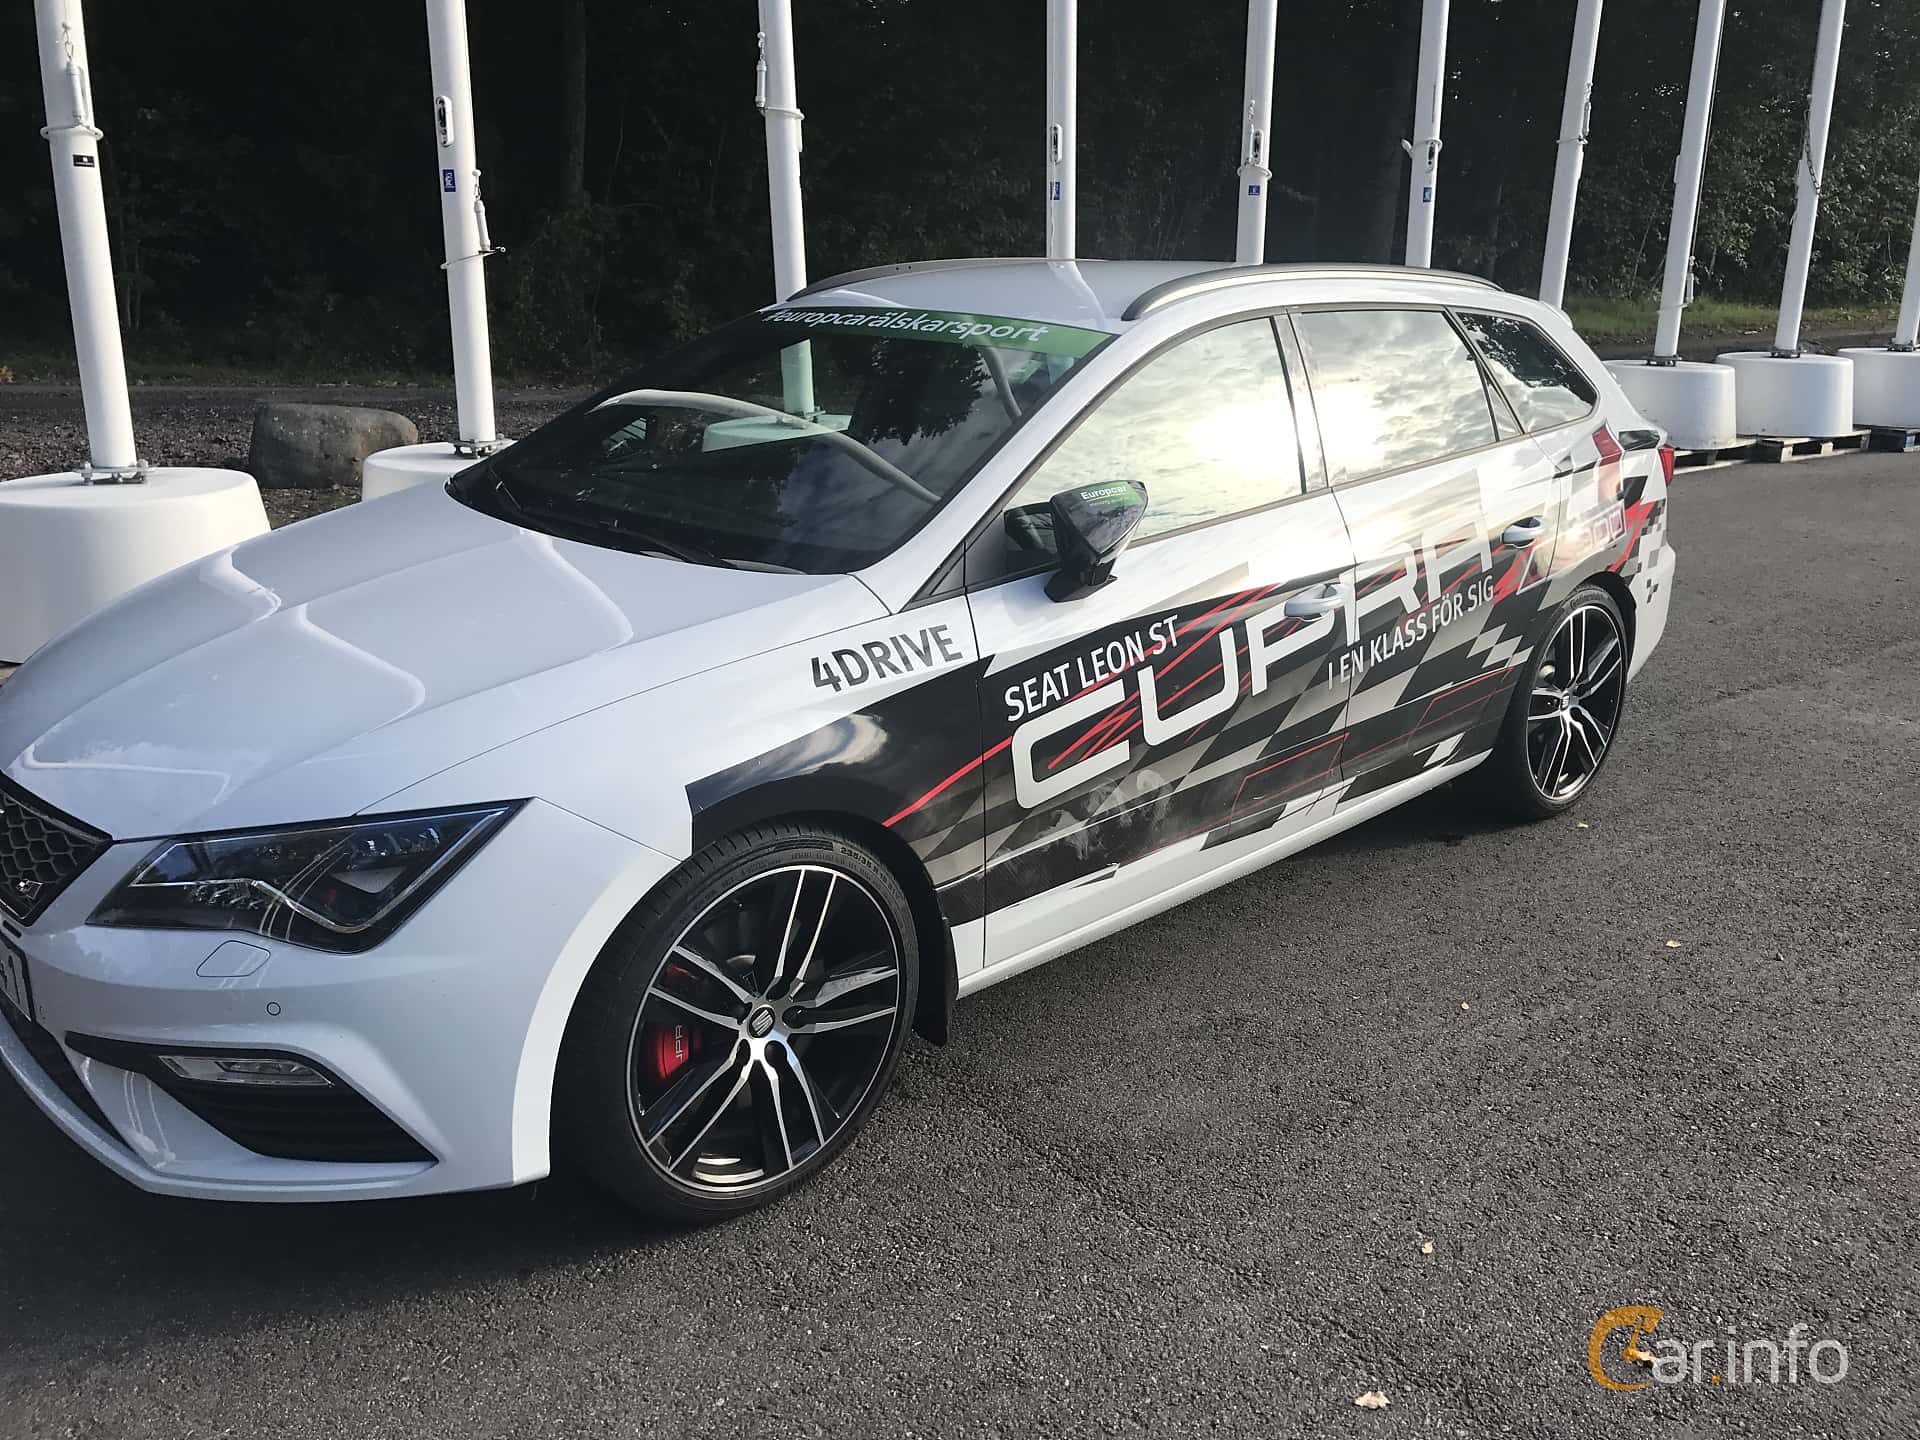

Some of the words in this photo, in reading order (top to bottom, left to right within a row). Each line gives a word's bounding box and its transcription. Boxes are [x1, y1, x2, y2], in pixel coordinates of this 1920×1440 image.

[810, 624, 963, 693] 4DRIVE
[1004, 662, 1070, 722] SEAT
[1077, 631, 1146, 689] LEON
[1149, 614, 1179, 655] ST
[1011, 500, 1494, 809] CUPRA
[1340, 645, 1364, 684] EN
[1370, 612, 1428, 668] KLASS
[1432, 592, 1464, 632] FÖR
[1468, 575, 1495, 612] SIG
